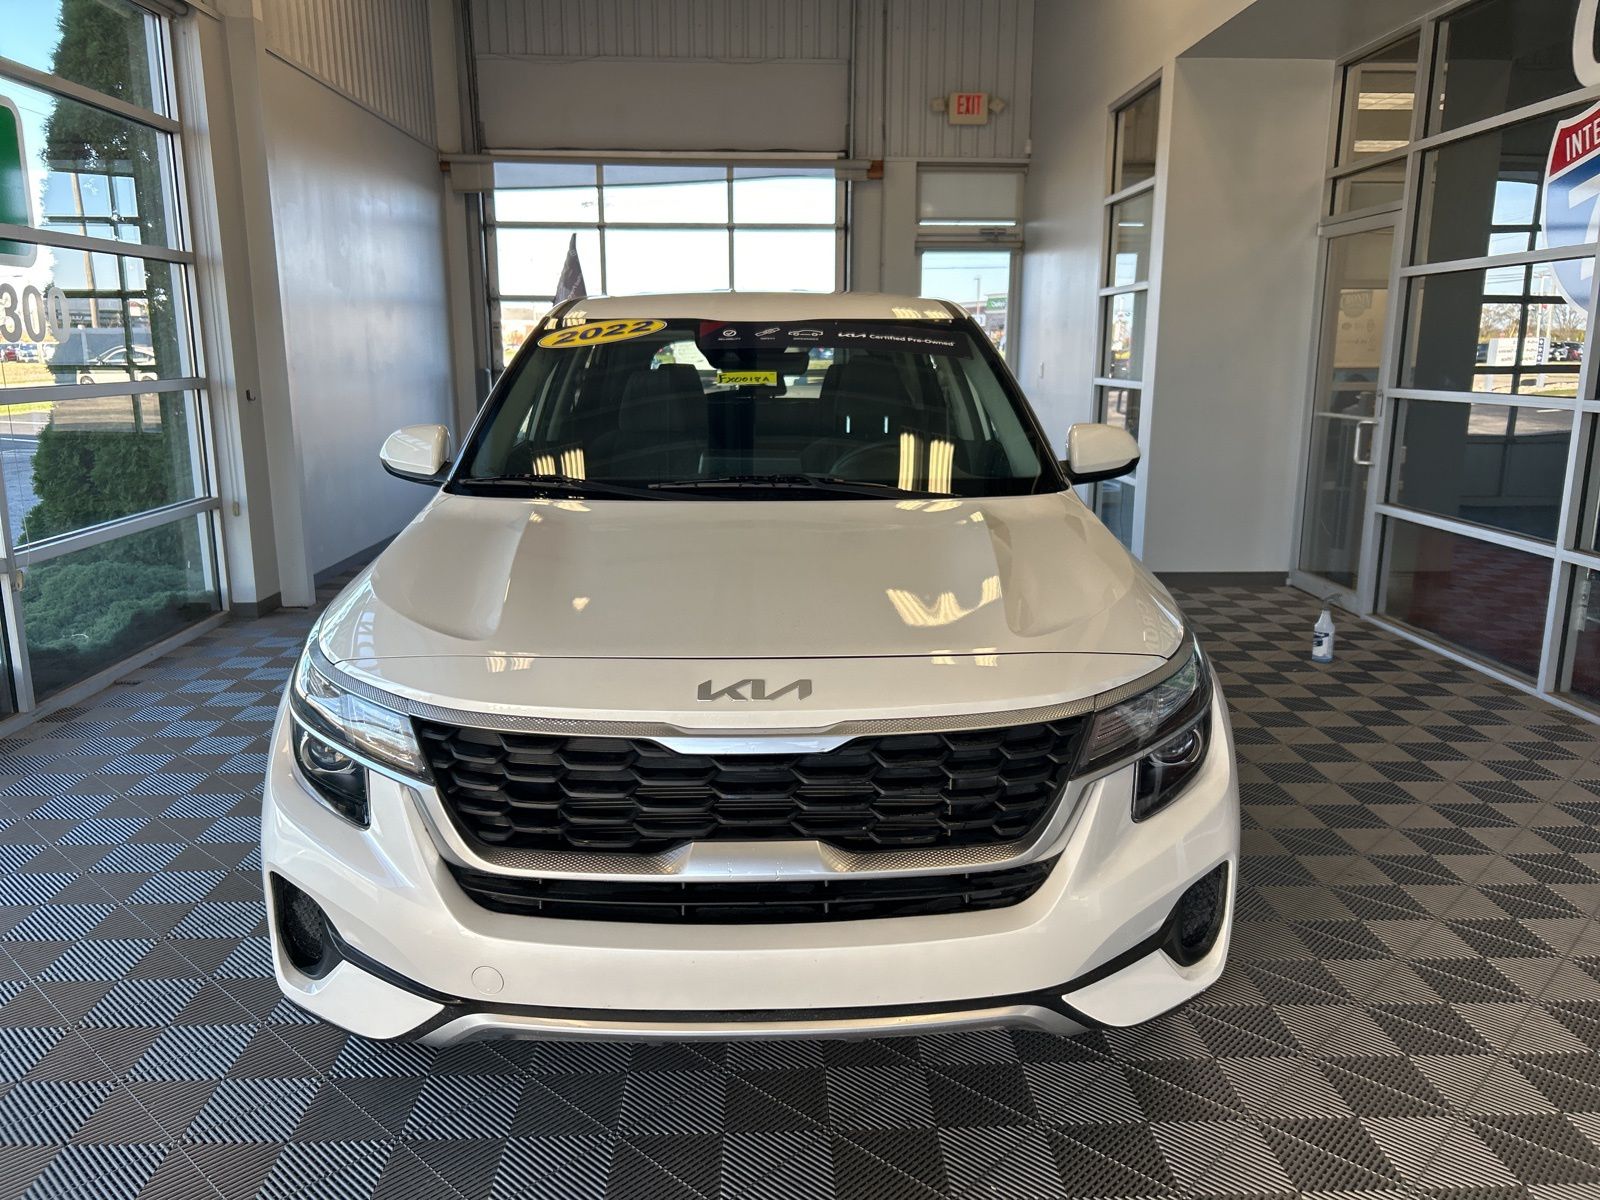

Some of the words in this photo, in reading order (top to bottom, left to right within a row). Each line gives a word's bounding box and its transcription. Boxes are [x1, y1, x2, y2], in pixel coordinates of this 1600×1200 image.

[957, 95, 983, 115] EXIT
[551, 320, 655, 346] 2022
[869, 333, 906, 342] Certified
[697, 679, 812, 701] KIA
